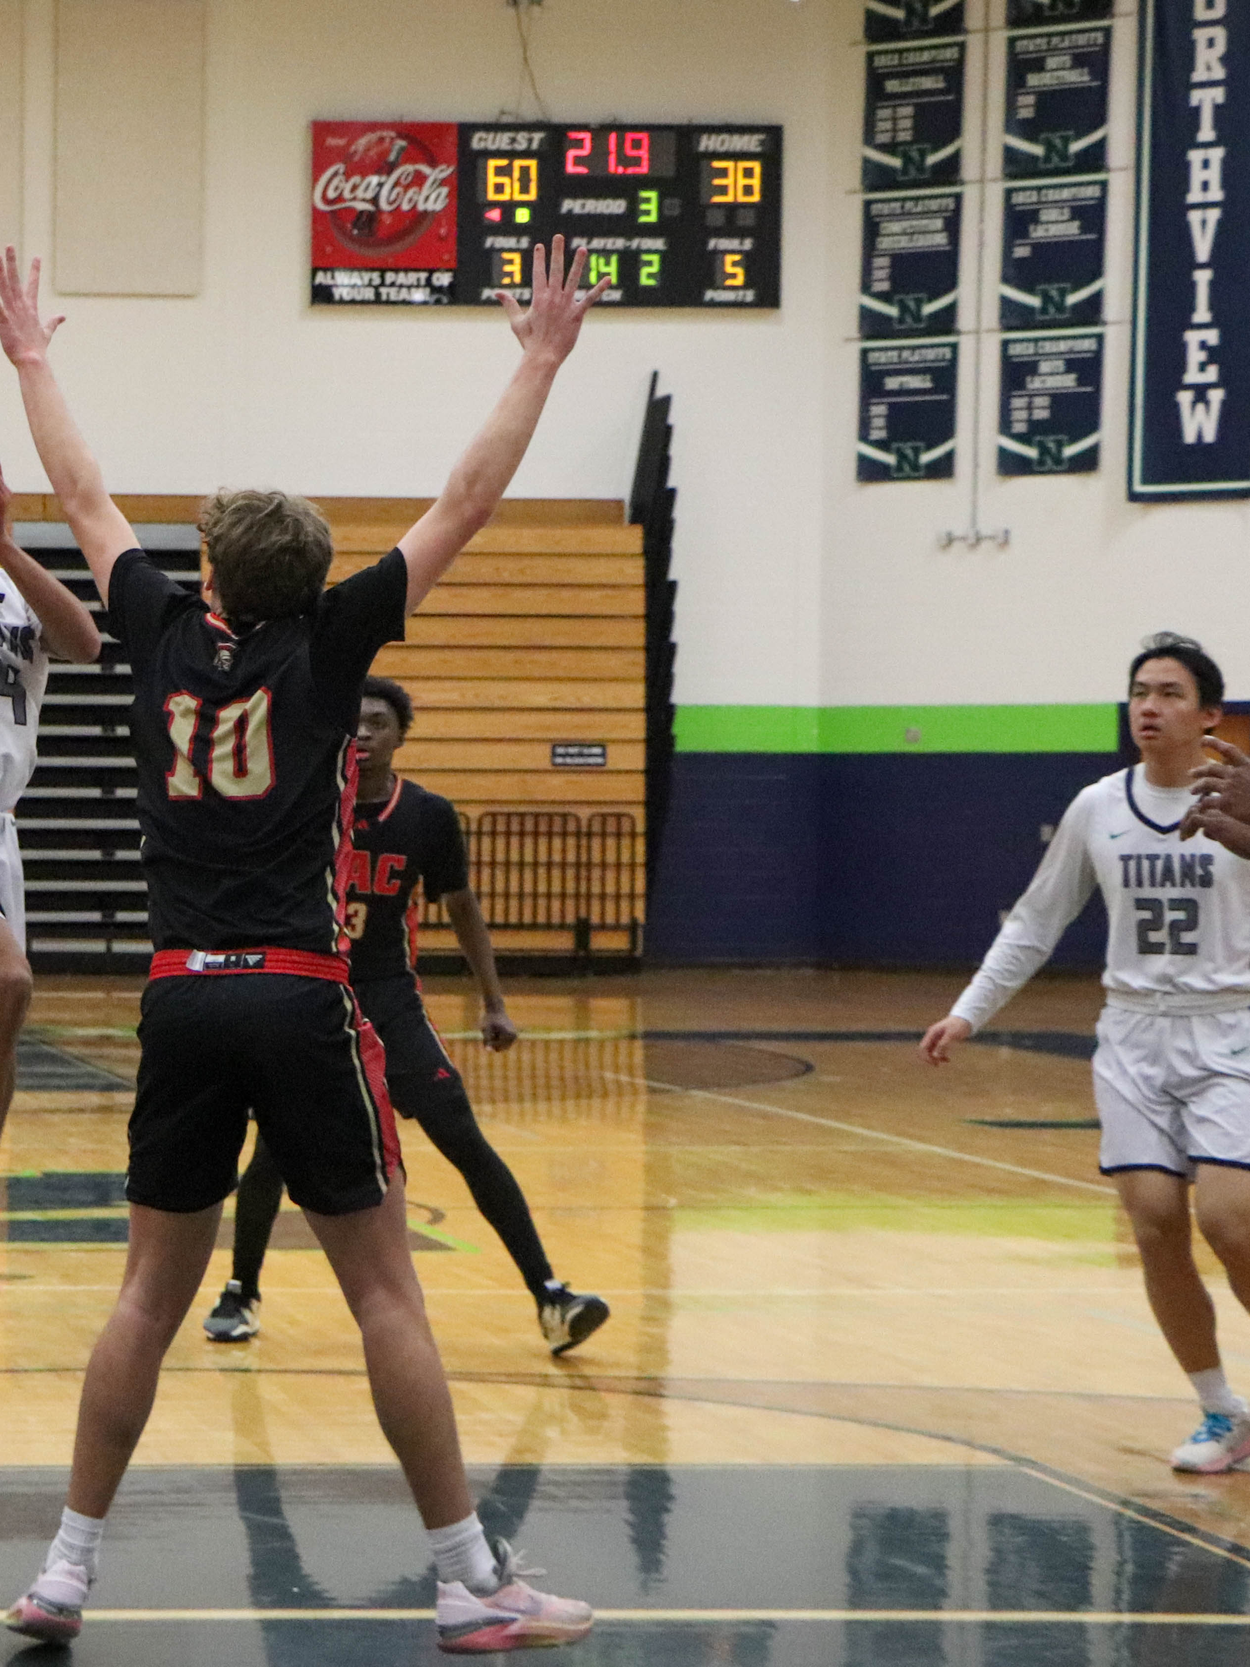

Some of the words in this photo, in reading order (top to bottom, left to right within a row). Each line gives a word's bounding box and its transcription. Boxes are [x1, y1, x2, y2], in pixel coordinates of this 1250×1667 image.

[471, 131, 546, 150] GUEST
[699, 133, 766, 152] HOME
[487, 159, 538, 201] 60
[710, 160, 762, 203] 38
[561, 199, 627, 215] PERIOD
[638, 190, 658, 223] 3
[314, 271, 382, 286] ALWAYS
[384, 271, 429, 286] PART
[431, 271, 454, 287] OF
[589, 253, 618, 286] 14
[639, 253, 661, 286] 2
[723, 254, 746, 287] 5
[332, 287, 376, 301] YOUR
[163, 686, 276, 800] 10
[345, 850, 408, 896] AC
[1118, 853, 1215, 888] TITANS
[1134, 897, 1200, 956] 22
